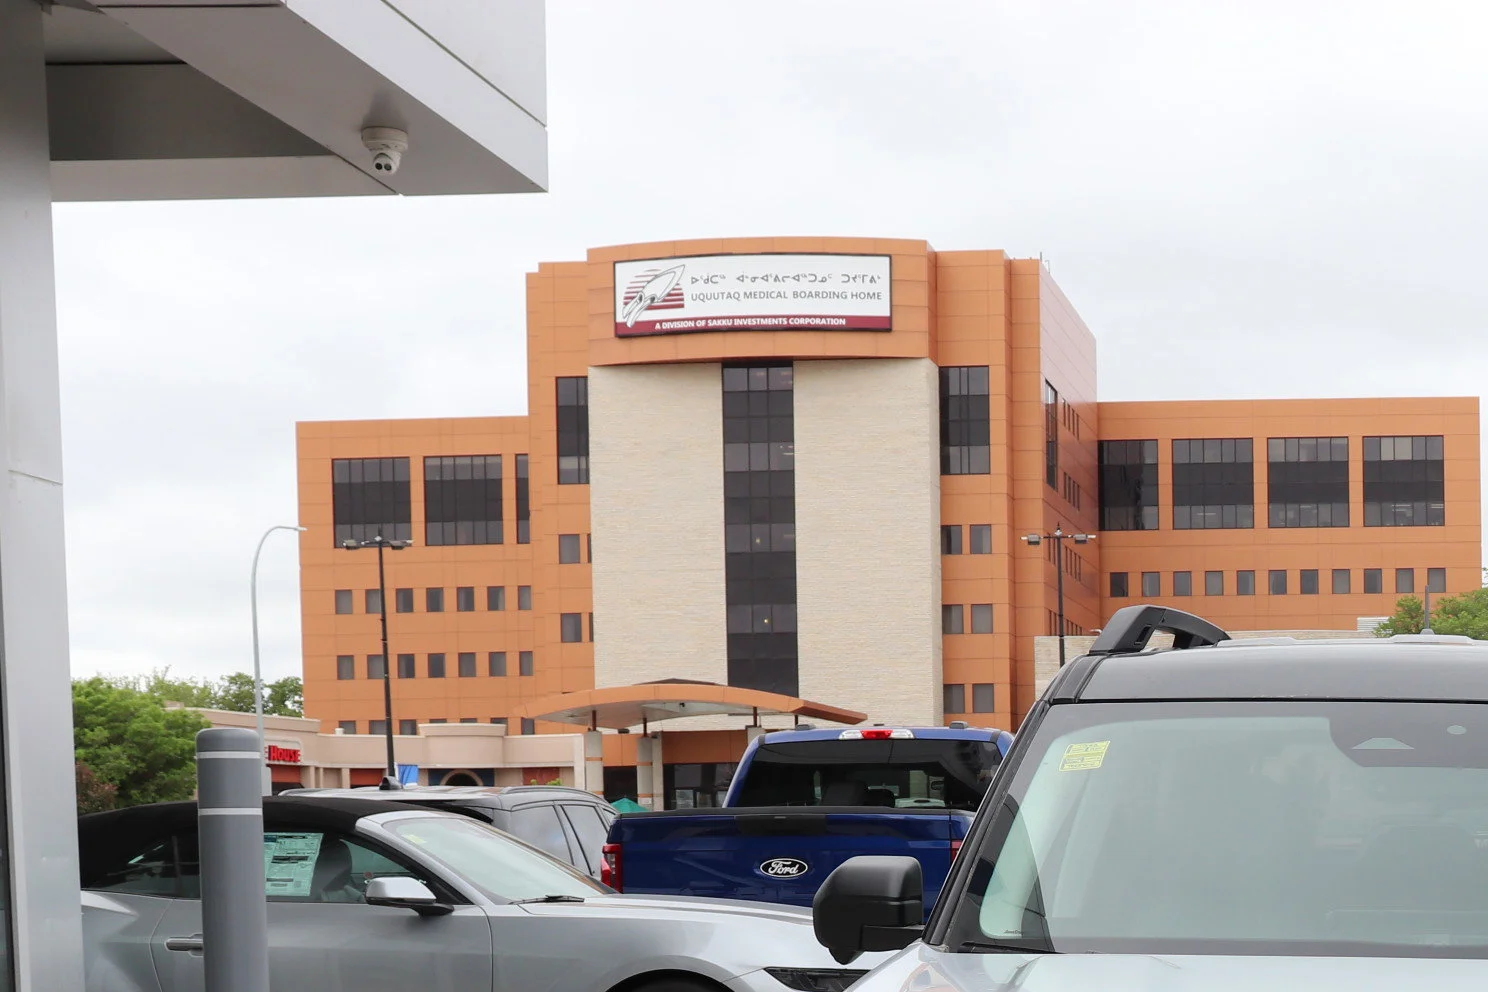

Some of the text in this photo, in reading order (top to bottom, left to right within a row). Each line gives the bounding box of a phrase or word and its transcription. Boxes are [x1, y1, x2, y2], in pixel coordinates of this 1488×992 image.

[691, 291, 882, 302] UQUUTAQ MEDICAL BOARDING HOME
[655, 317, 847, 330] A DIVISION OF SAKKU INVESTMENTS CORPORATION
[768, 860, 800, 875] Ford
